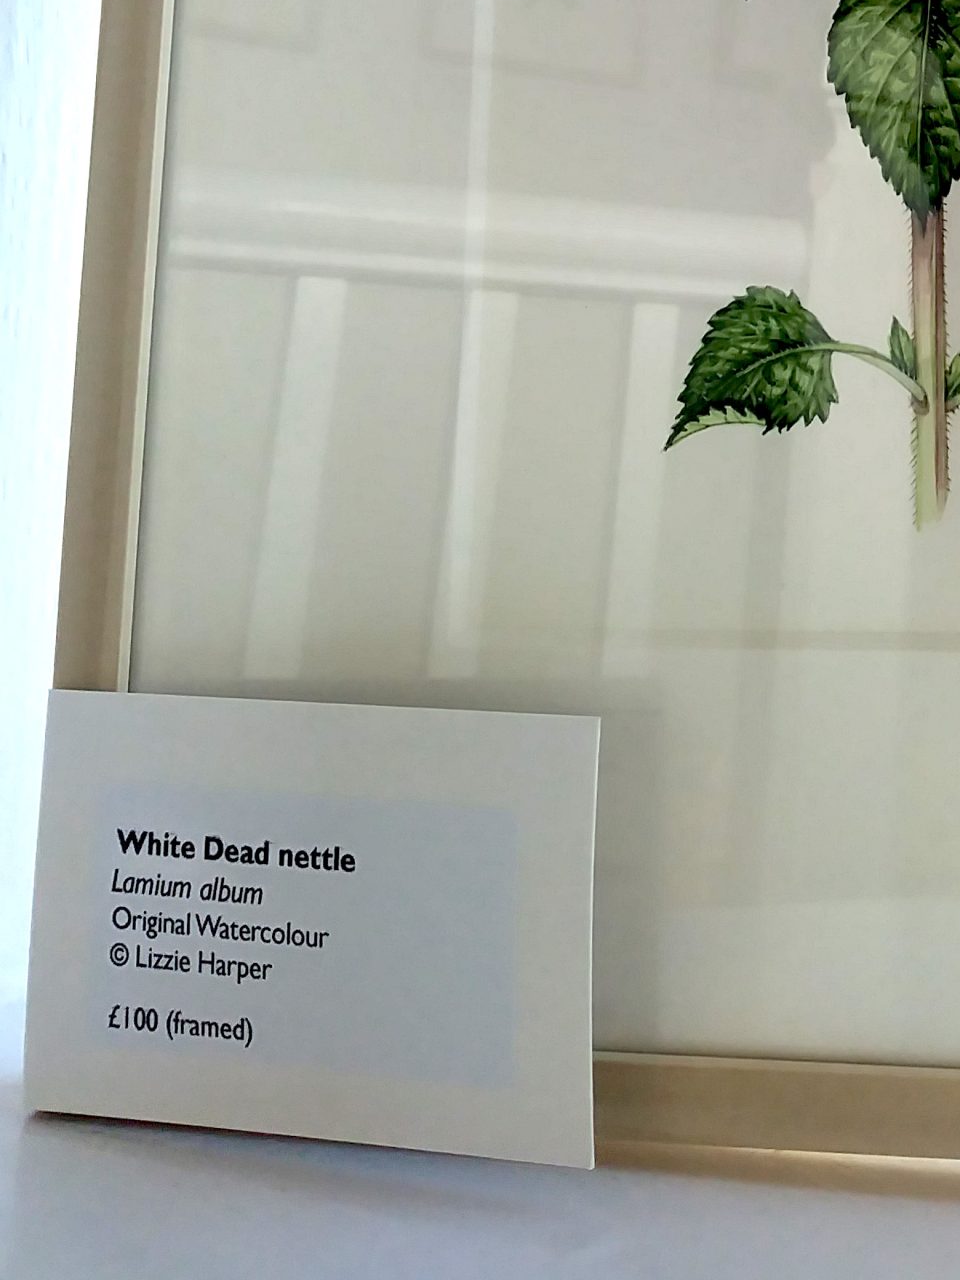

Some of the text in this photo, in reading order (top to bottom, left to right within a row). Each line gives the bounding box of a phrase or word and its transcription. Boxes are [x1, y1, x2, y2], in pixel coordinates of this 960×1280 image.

[116, 828, 356, 873] White Dead nettle
[111, 868, 264, 905] Lamium album
[111, 905, 330, 949] Original Watercolour
[135, 944, 191, 973] Lizzie
[197, 950, 273, 985] Harper
[108, 1004, 254, 1049] £100 (framed)
